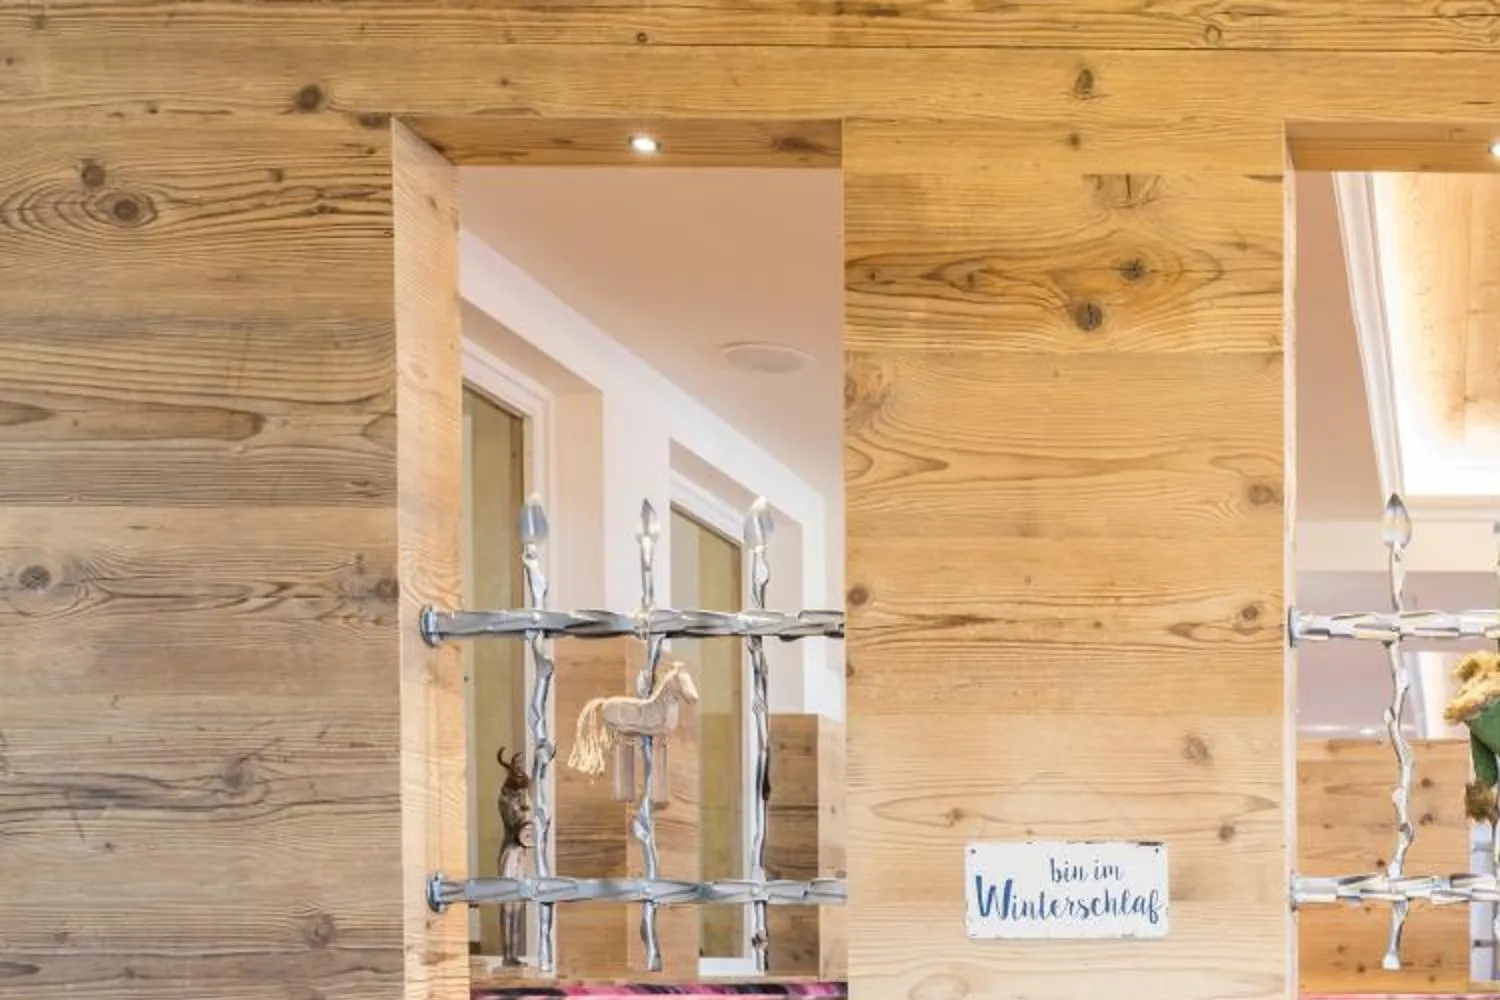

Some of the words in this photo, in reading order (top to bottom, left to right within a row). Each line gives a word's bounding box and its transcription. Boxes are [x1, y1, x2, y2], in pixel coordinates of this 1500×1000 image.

[1050, 857, 1087, 883] bin
[1094, 859, 1121, 882] im
[975, 875, 1161, 925] Winterschlaf
